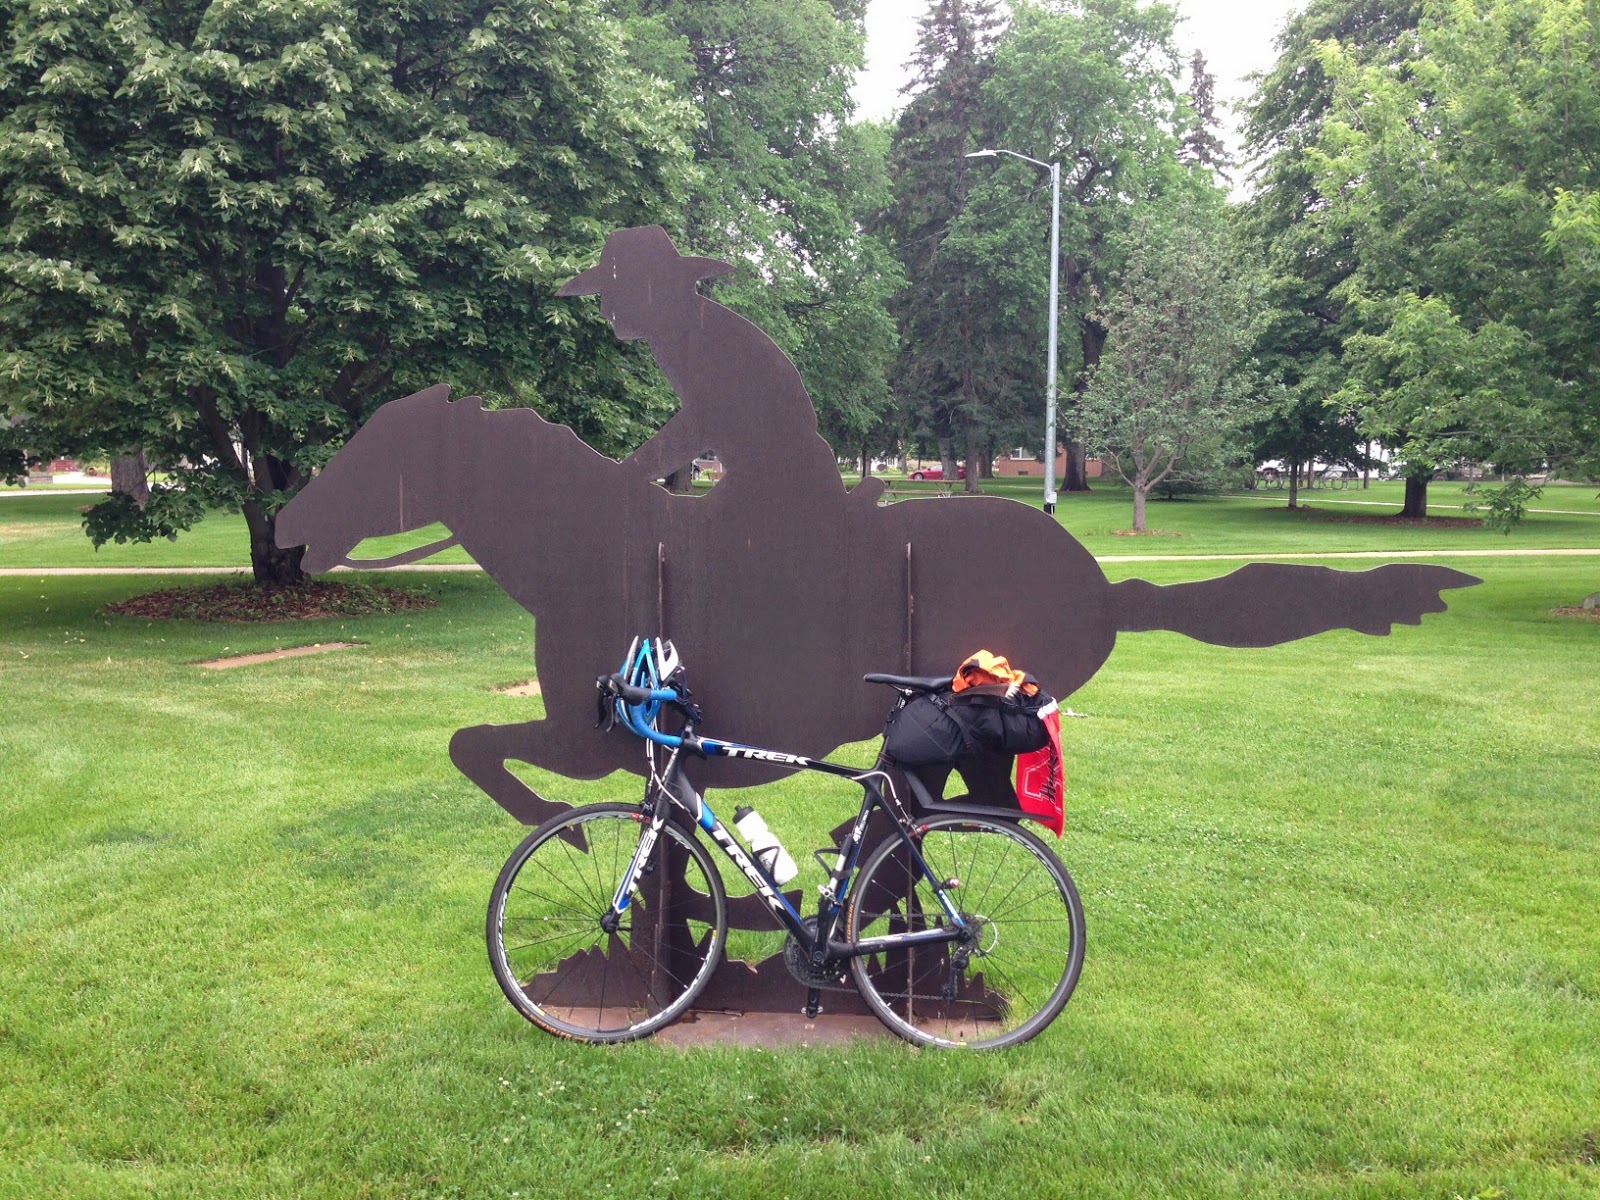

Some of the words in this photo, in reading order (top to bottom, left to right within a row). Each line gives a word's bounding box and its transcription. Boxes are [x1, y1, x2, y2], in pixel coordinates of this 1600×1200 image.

[722, 746, 812, 766] TREK
[626, 815, 665, 895] TREK
[712, 821, 785, 911] TREK
